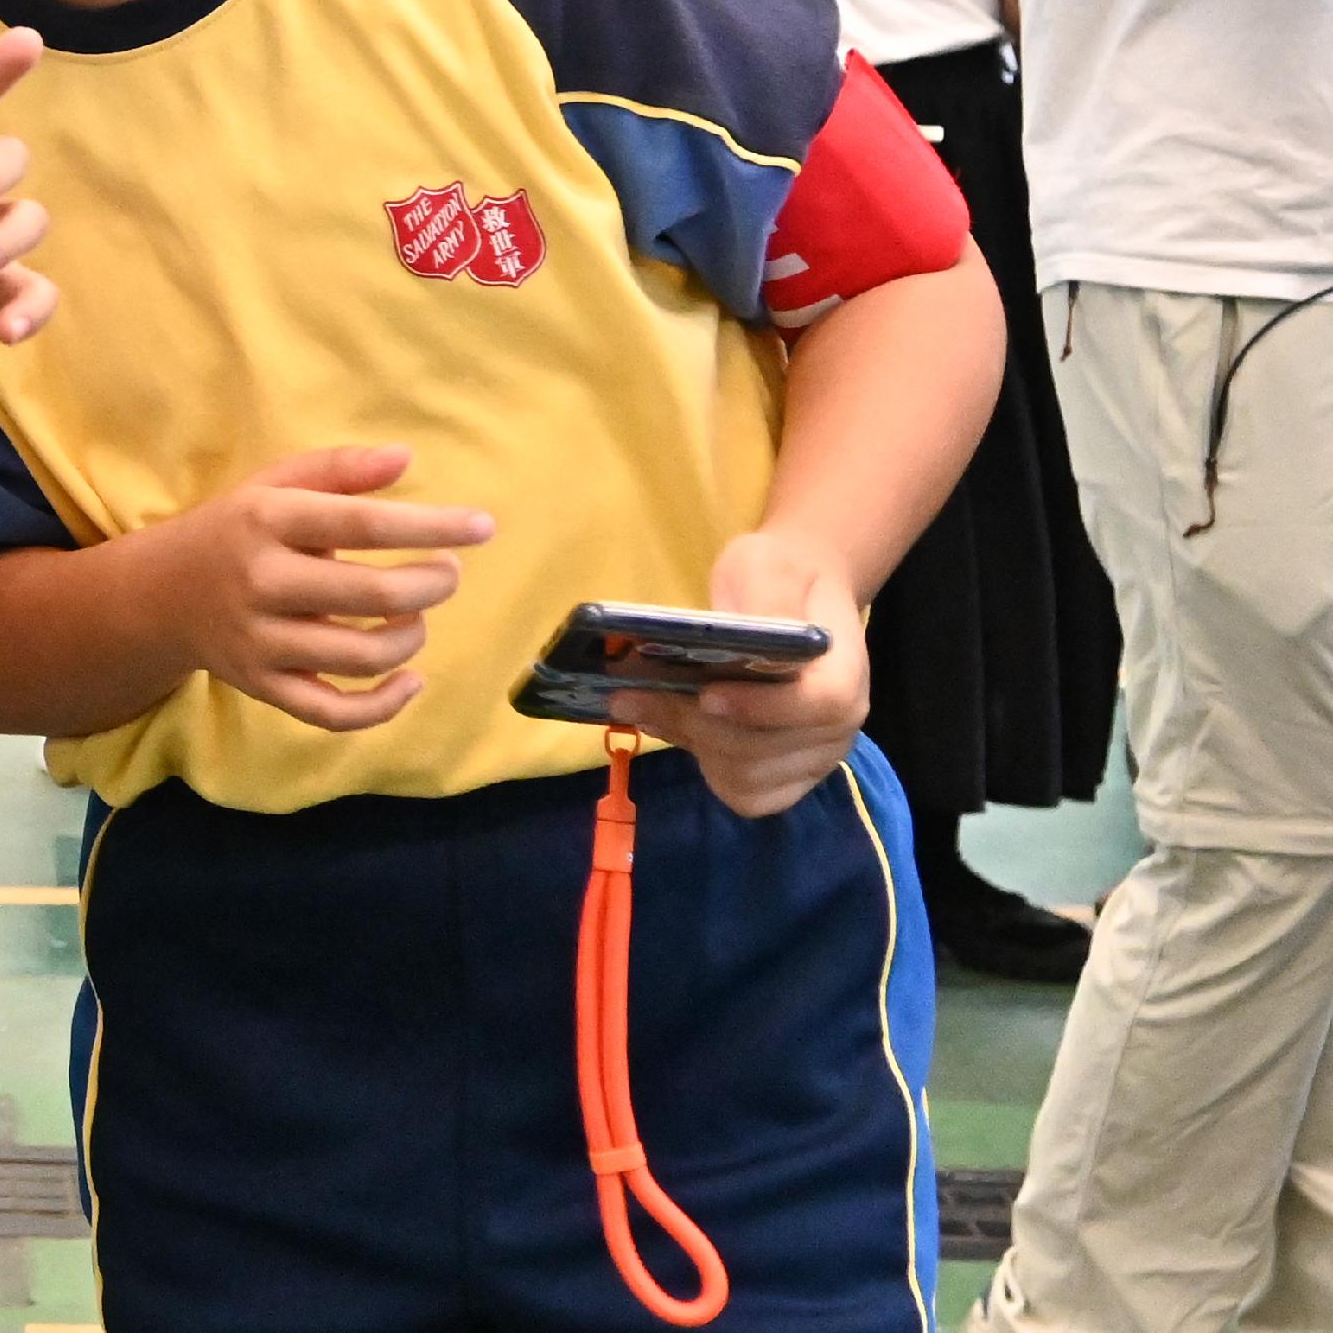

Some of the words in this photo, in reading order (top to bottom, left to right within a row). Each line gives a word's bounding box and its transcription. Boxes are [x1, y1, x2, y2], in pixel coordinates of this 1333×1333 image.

[403, 193, 464, 264] SALVATION
[404, 198, 434, 231] THE
[433, 220, 465, 269] ARMY
[483, 205, 526, 279] 救世軍
